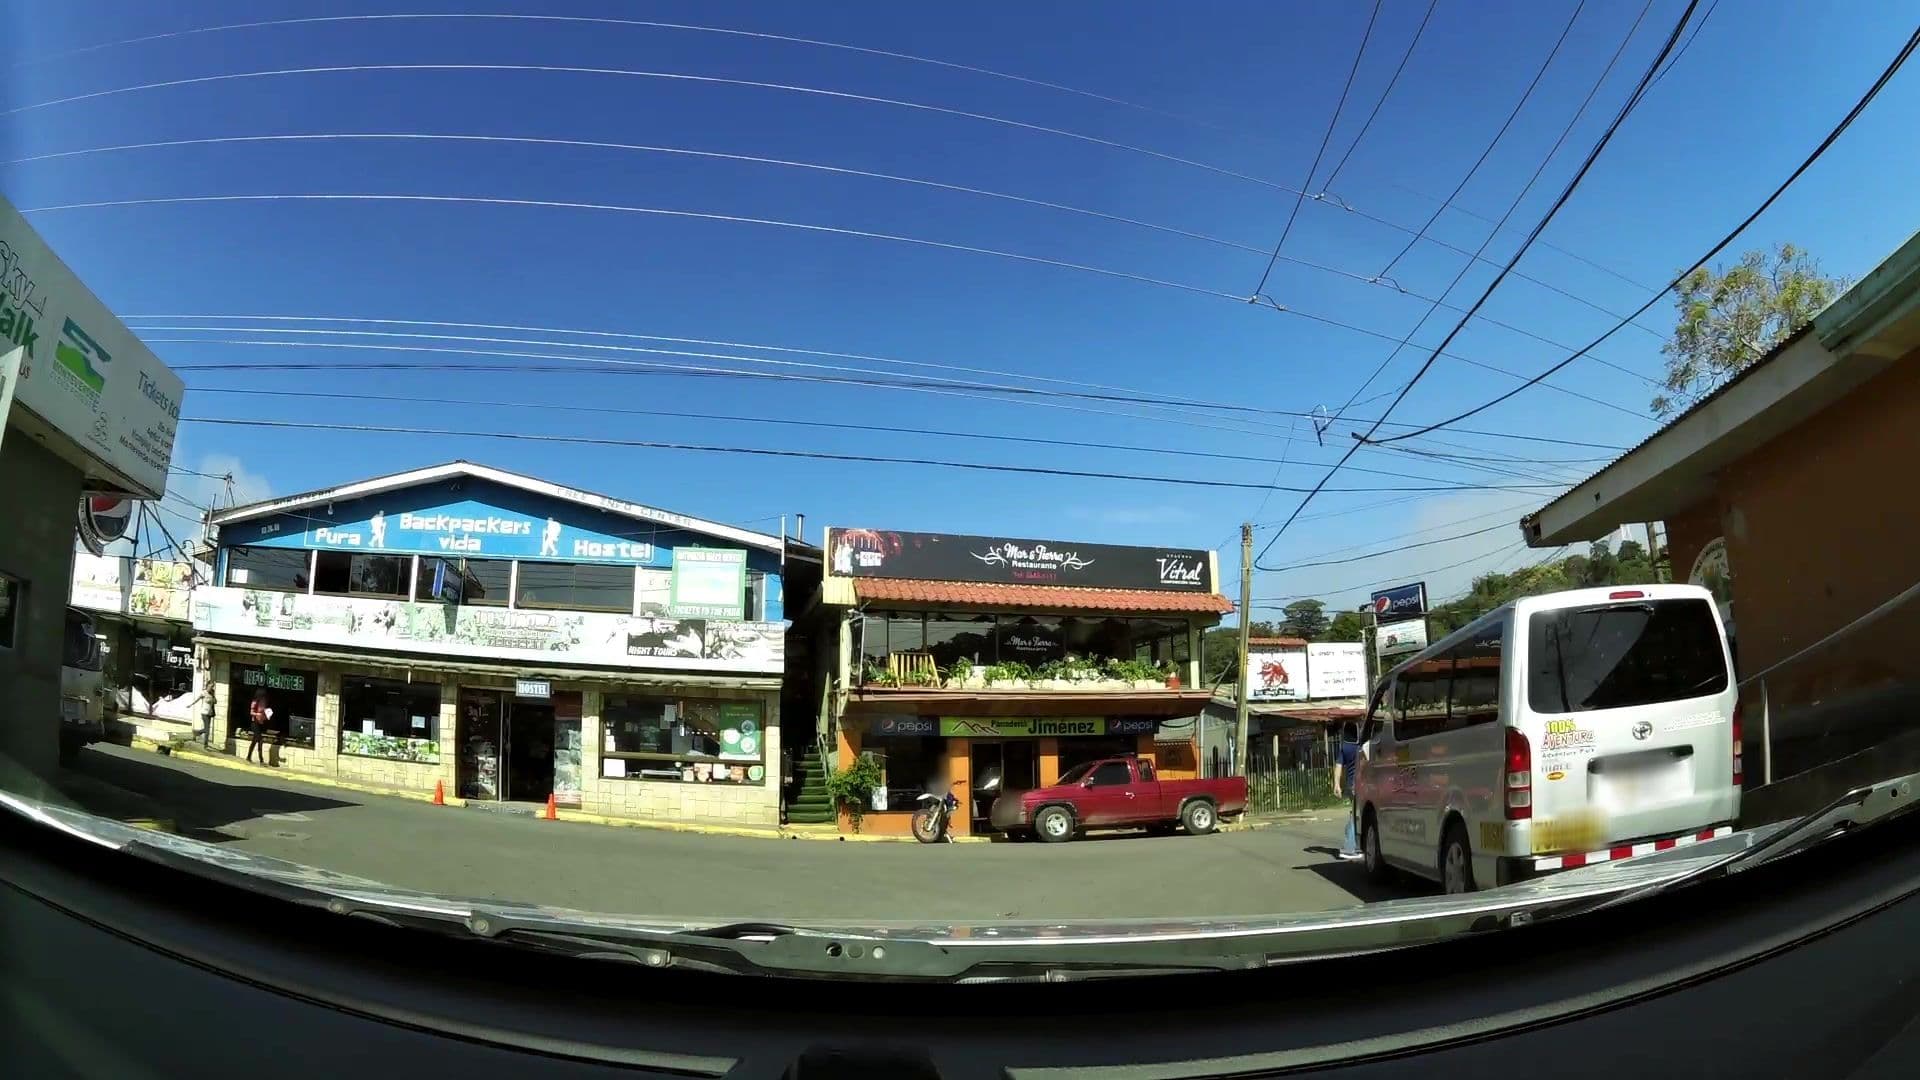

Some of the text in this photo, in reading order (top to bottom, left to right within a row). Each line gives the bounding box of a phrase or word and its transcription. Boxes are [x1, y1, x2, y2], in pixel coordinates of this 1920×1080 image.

[138, 370, 169, 410] Tickets
[315, 528, 361, 546] Pura
[574, 540, 652, 560] Hostel
[1004, 543, 1027, 560] Mar
[1035, 545, 1063, 562] Tierra
[1012, 560, 1057, 570] Restaurante
[1156, 558, 1203, 581] Vitral
[1392, 595, 1418, 610] pepsi
[244, 670, 305, 691] INFO CENTER
[518, 683, 546, 695] HOSTEL
[897, 721, 933, 732] pepsi
[1123, 720, 1153, 732] pepsi
[1546, 719, 1577, 734] 100%
[1543, 730, 1596, 749] AVENTURA
